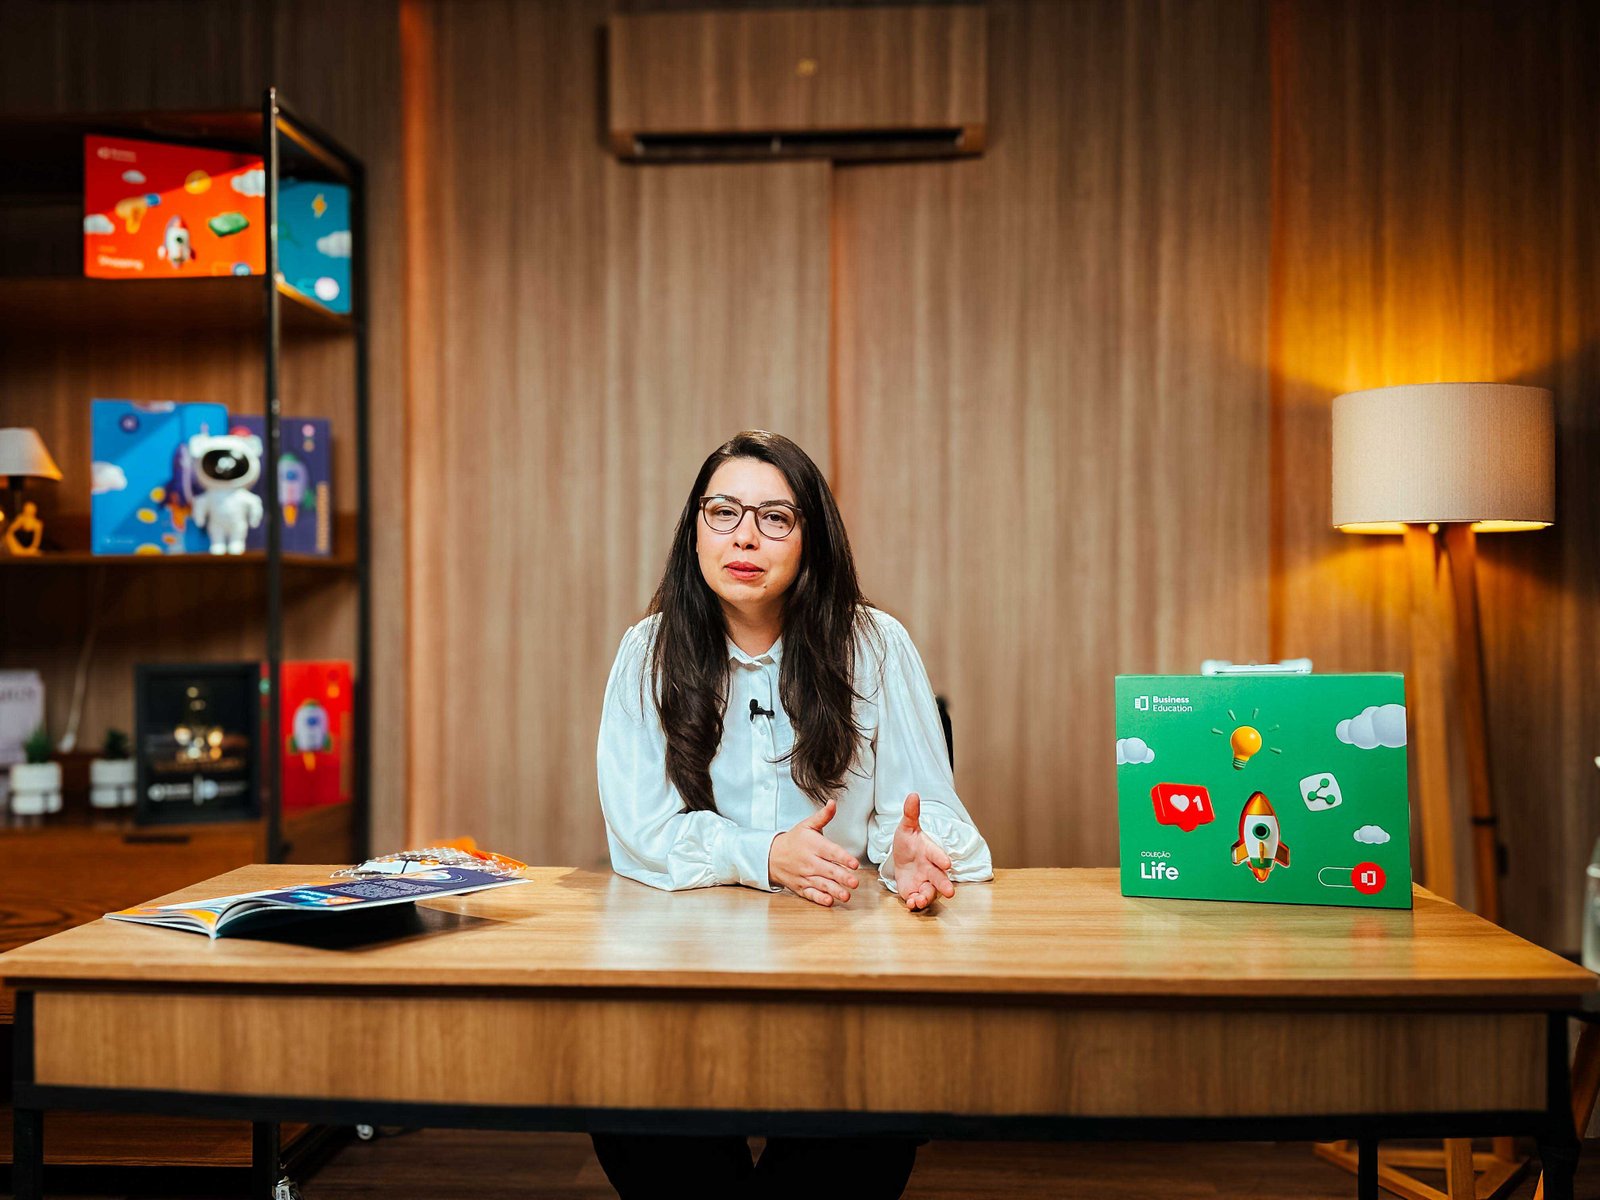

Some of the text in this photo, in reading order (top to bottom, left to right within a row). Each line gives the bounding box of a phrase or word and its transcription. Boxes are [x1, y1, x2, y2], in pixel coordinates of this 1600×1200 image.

[1152, 696, 1190, 704] Business
[1152, 704, 1193, 712] Education
[1192, 795, 1204, 812] 1
[1140, 850, 1171, 859] COLEÇÃO
[1140, 861, 1179, 880] Life
